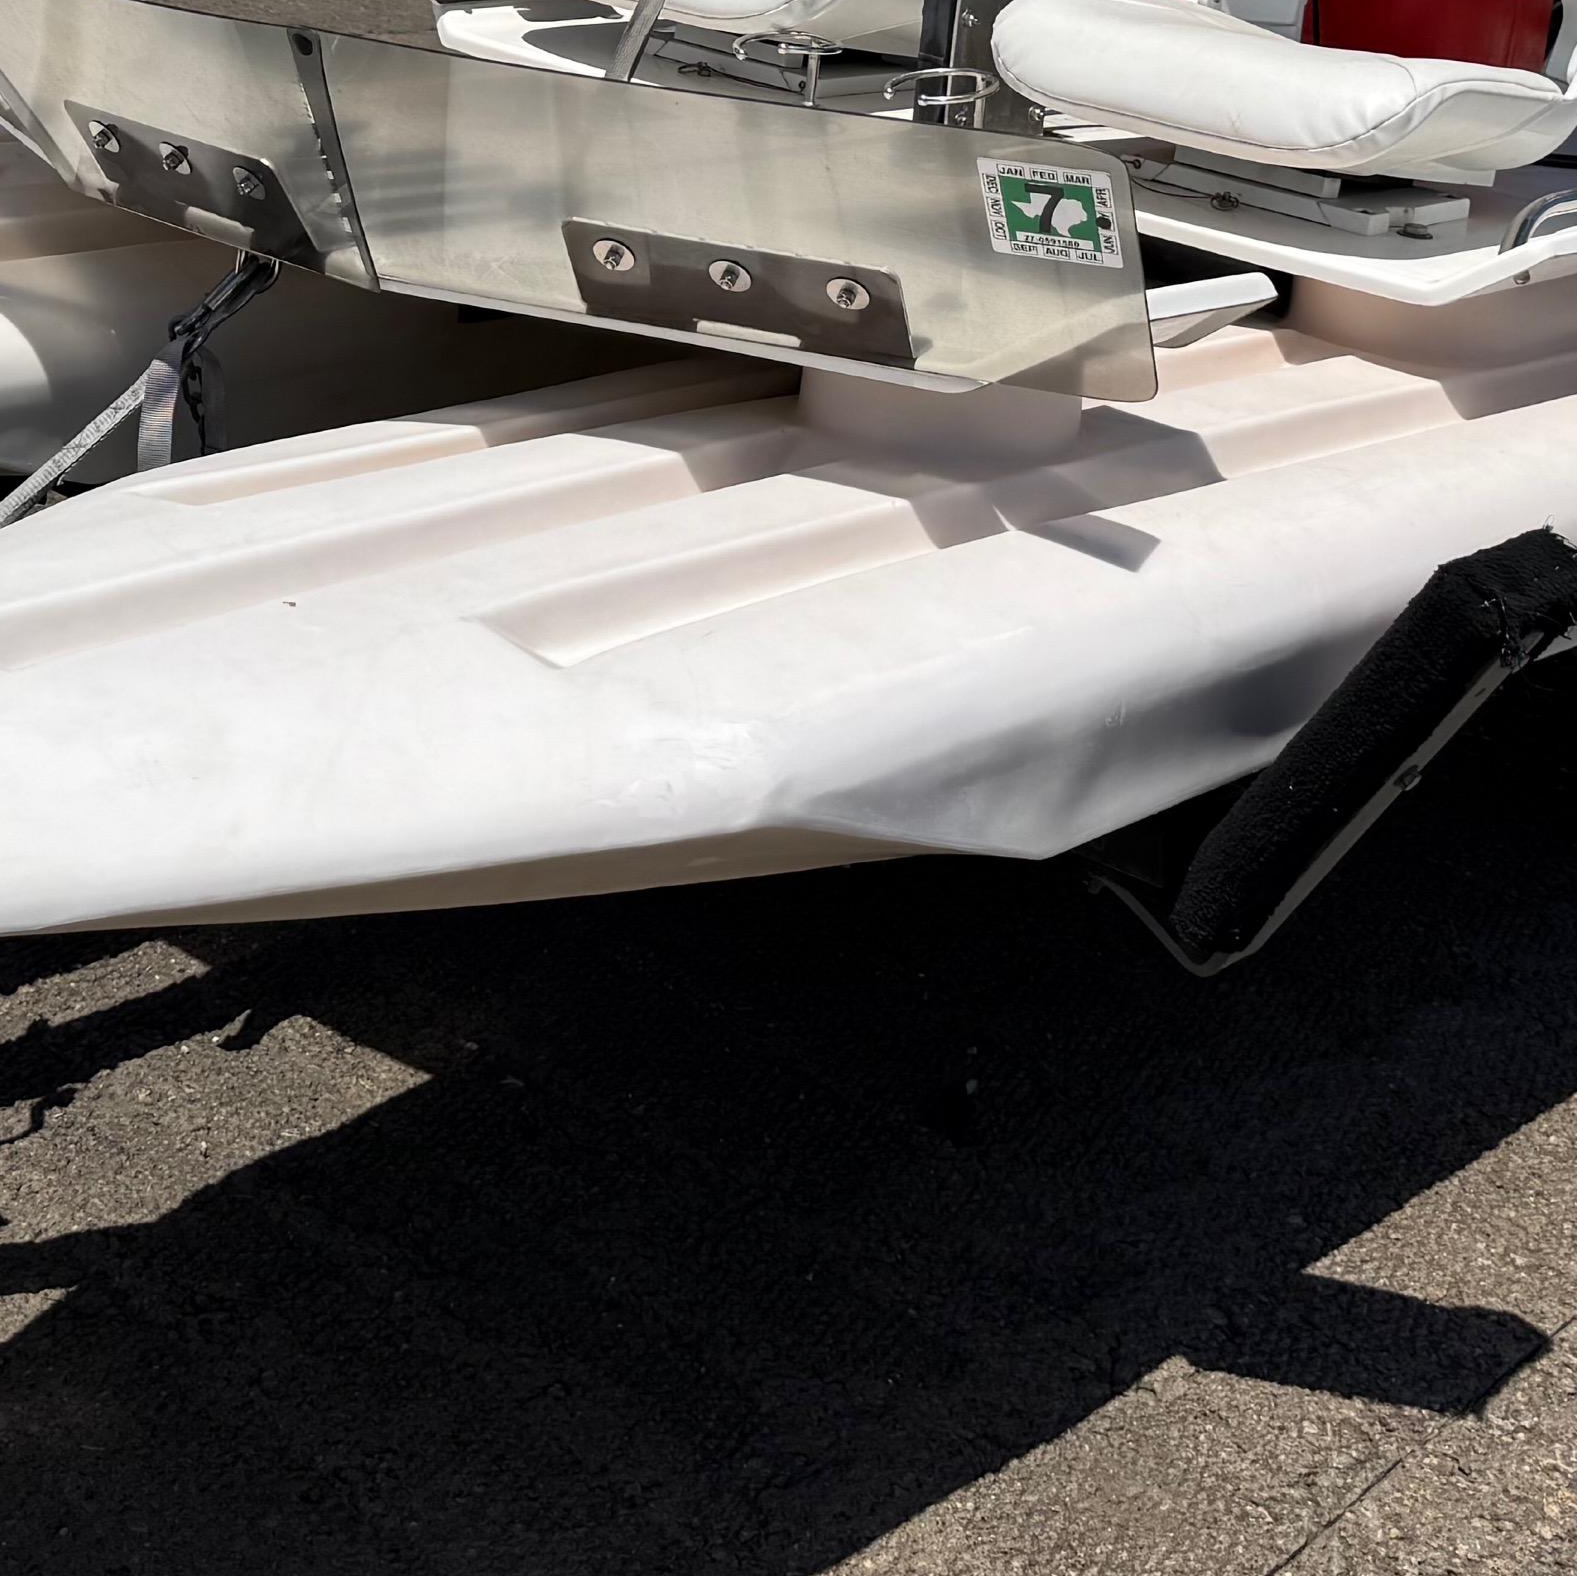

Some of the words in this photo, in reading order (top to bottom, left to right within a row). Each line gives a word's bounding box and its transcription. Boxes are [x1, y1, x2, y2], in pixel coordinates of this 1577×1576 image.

[999, 166, 1024, 178] JAN
[1065, 174, 1091, 184] MAR
[1025, 182, 1064, 233] 7
[1104, 234, 1116, 254] JUN
[1045, 247, 1070, 258] AUG
[1077, 252, 1102, 262] JUL
